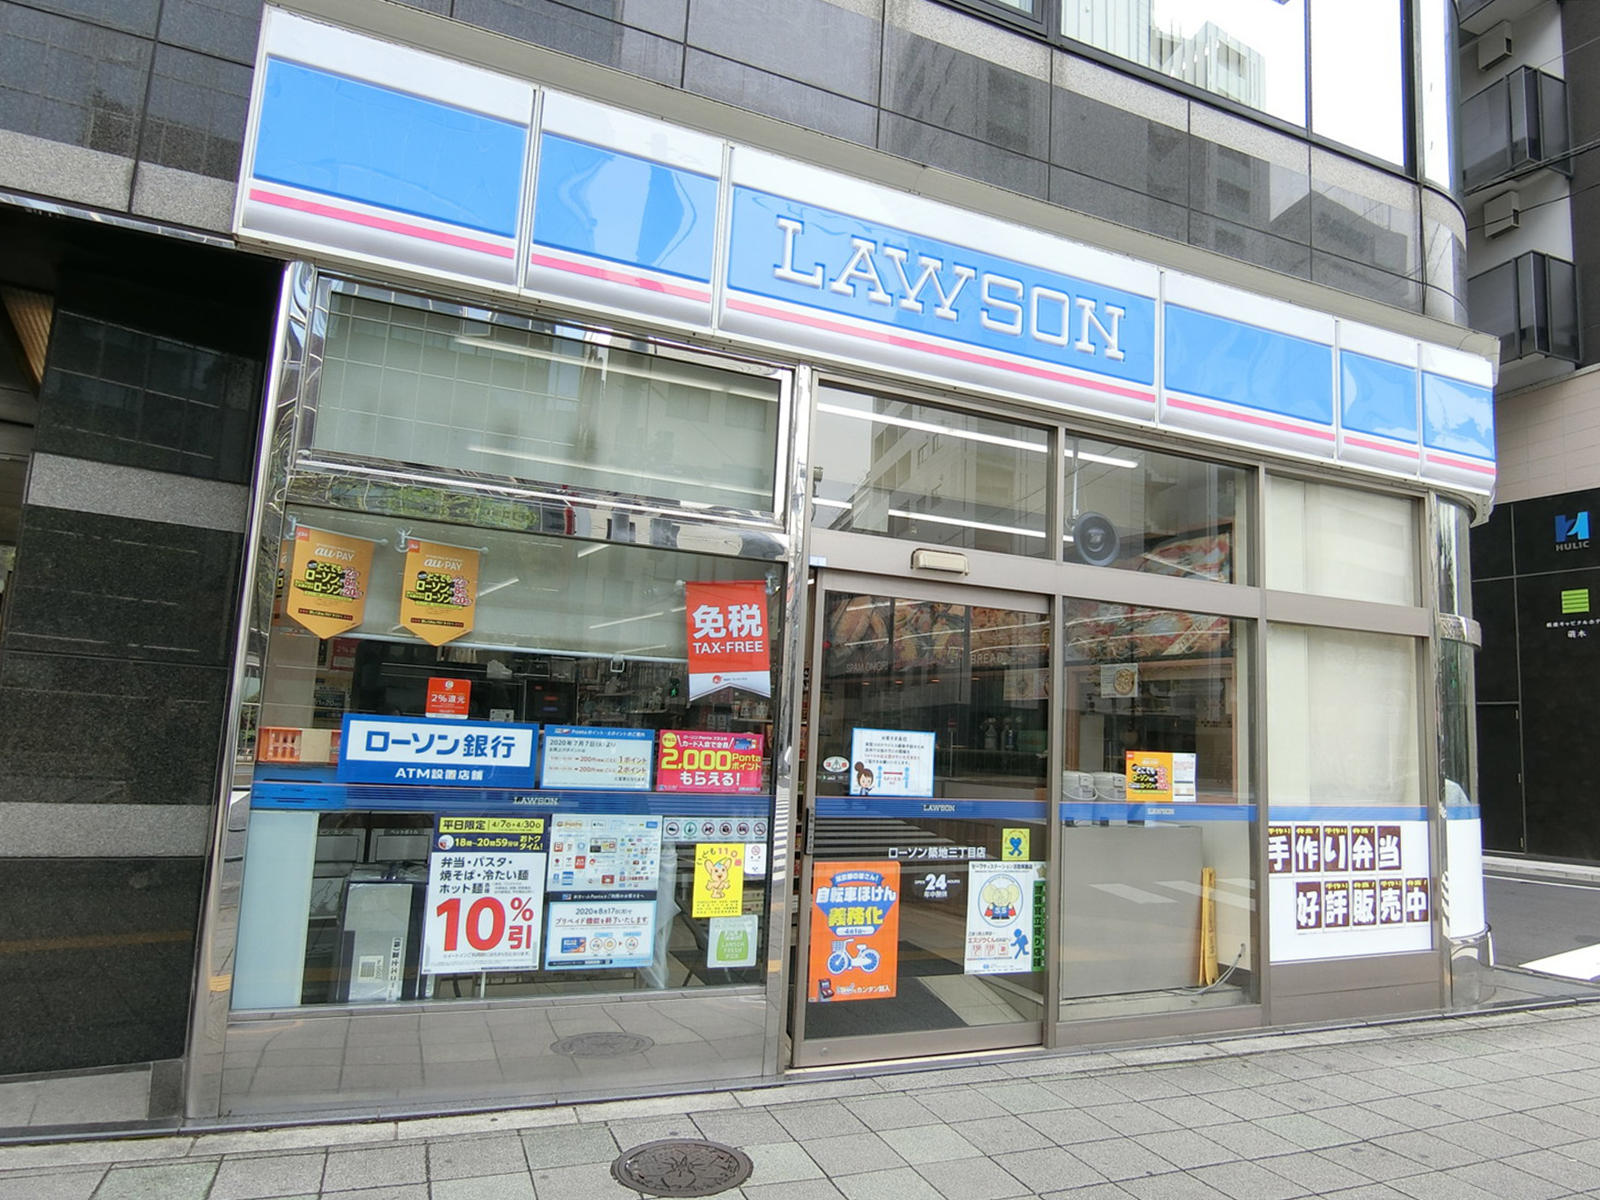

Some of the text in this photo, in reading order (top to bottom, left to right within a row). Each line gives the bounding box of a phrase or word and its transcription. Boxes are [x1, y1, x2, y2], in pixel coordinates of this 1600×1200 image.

[773, 214, 1125, 361] LAWSON
[1555, 540, 1590, 552] HULIC
[336, 551, 355, 561] PAY
[445, 561, 463, 571] PAY
[306, 569, 340, 583] ローソン
[416, 580, 450, 593] ローソン
[692, 603, 763, 639] 免税
[692, 641, 764, 654] TAX-FREE
[365, 730, 516, 759] ローソン銀行
[661, 748, 732, 771] 2,000
[732, 752, 762, 762] Ponta
[731, 761, 762, 771] ポイント
[395, 767, 484, 781] ATM設置店舗
[680, 771, 741, 786] もらえる!
[513, 796, 559, 805] LAWSON
[923, 804, 956, 812] LAWSON
[443, 819, 486, 831] 平日限定
[889, 846, 986, 859] ローソン築地三丁目店
[1268, 835, 1400, 871] 手作り弁当
[925, 873, 947, 890] 24
[815, 886, 897, 903] 自転車ほけん
[1296, 886, 1428, 927] 好評販売中
[828, 906, 884, 927] 義務化
